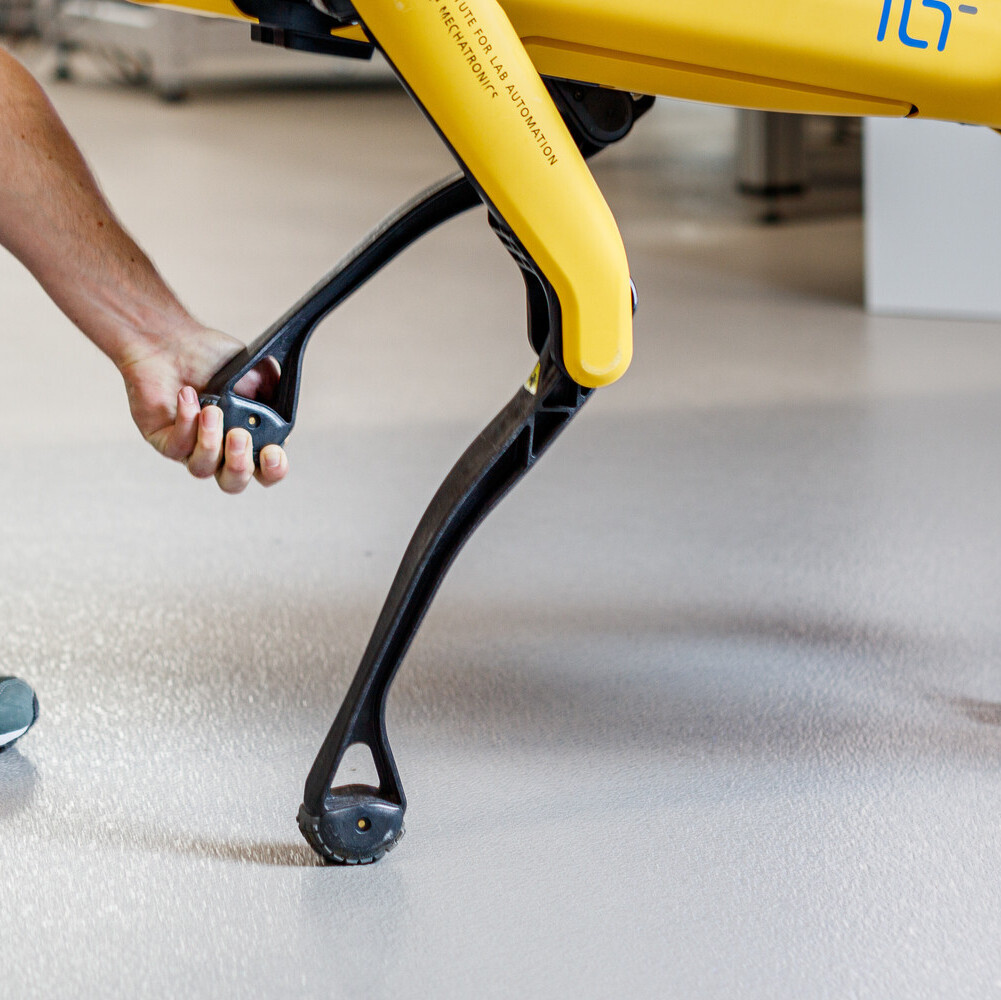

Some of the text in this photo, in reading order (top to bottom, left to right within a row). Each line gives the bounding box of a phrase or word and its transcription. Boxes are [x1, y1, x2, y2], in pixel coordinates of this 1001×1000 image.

[473, 28, 493, 55] FOR
[490, 56, 509, 81] LAB
[505, 84, 558, 166] AUTOMATION
